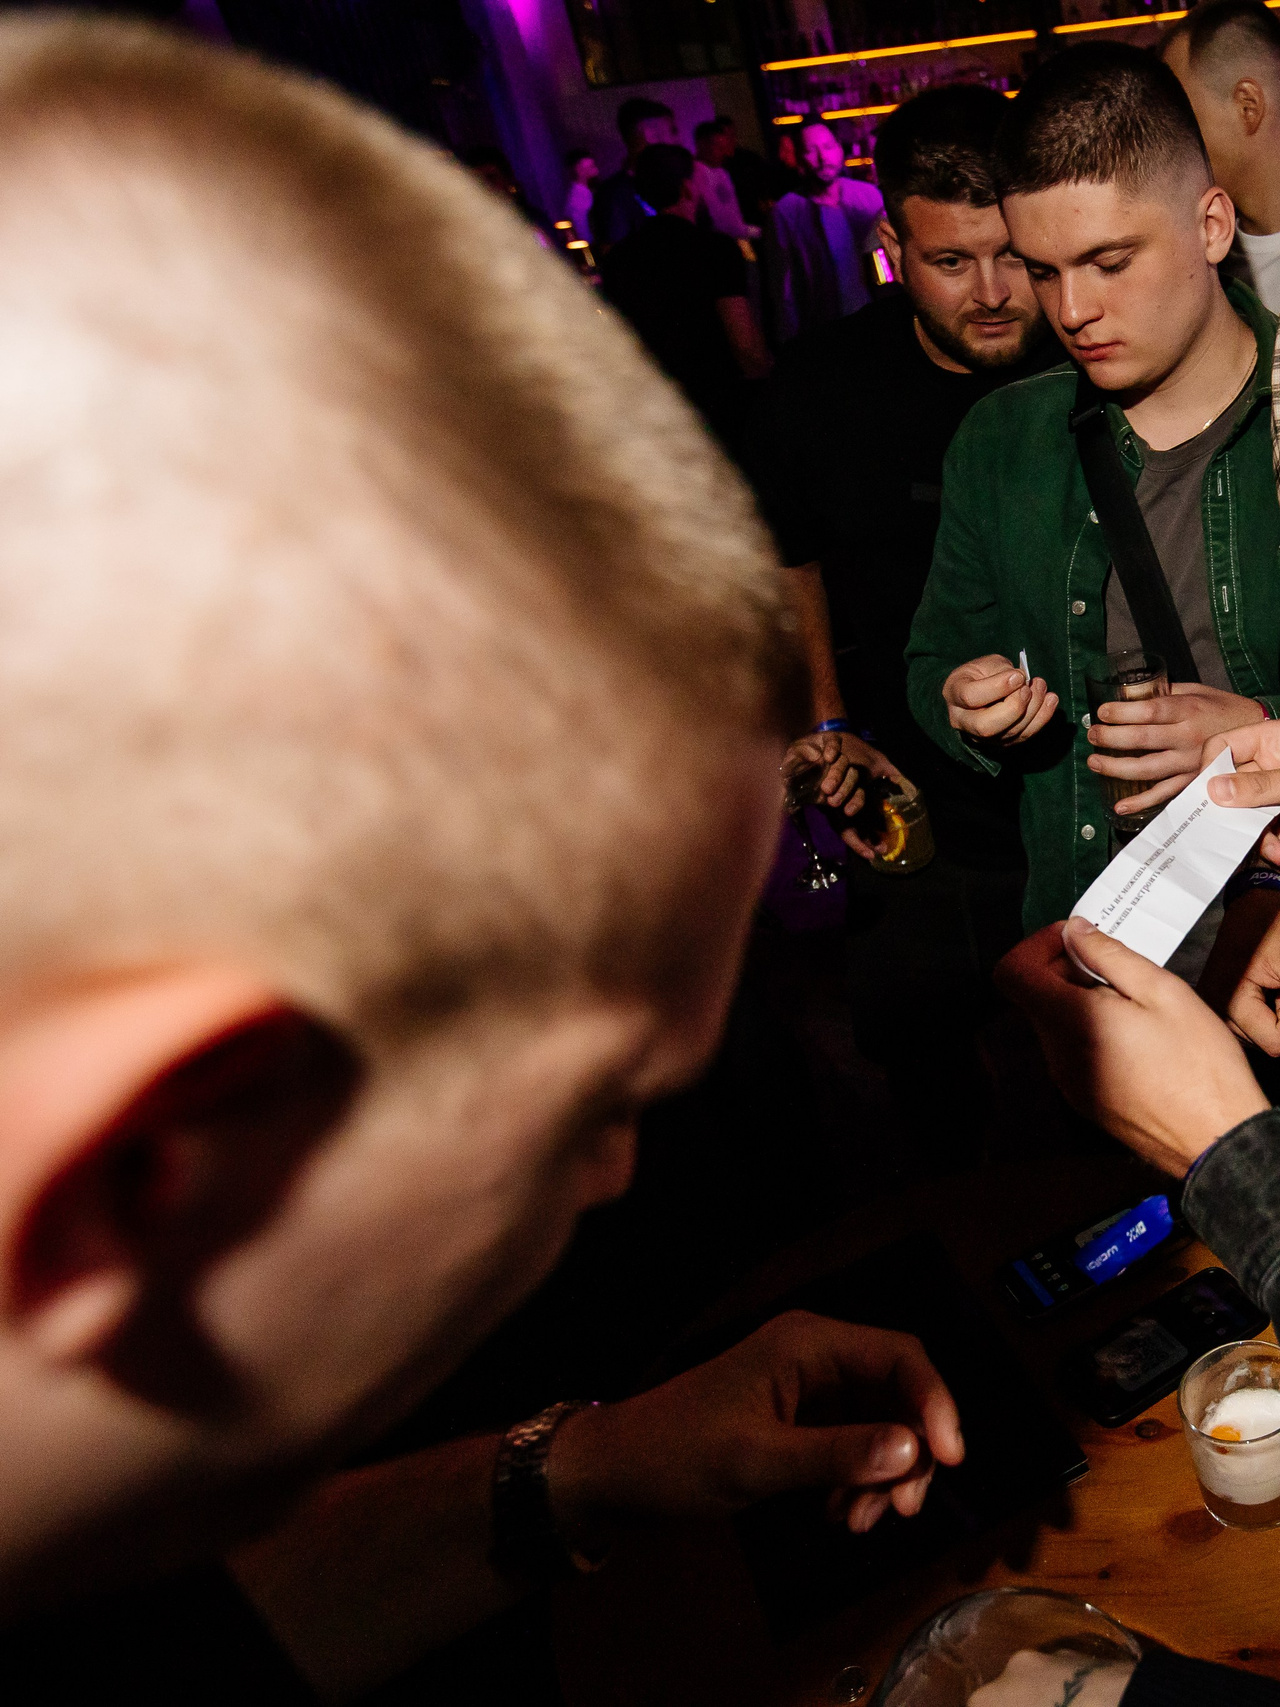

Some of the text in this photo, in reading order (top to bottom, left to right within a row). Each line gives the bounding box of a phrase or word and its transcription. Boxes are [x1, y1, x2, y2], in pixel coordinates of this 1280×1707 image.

[1107, 907, 1132, 935] можешь
[1130, 871, 1161, 906] настроить
[1113, 895, 1123, 904] не
[1121, 866, 1147, 894] можешь
